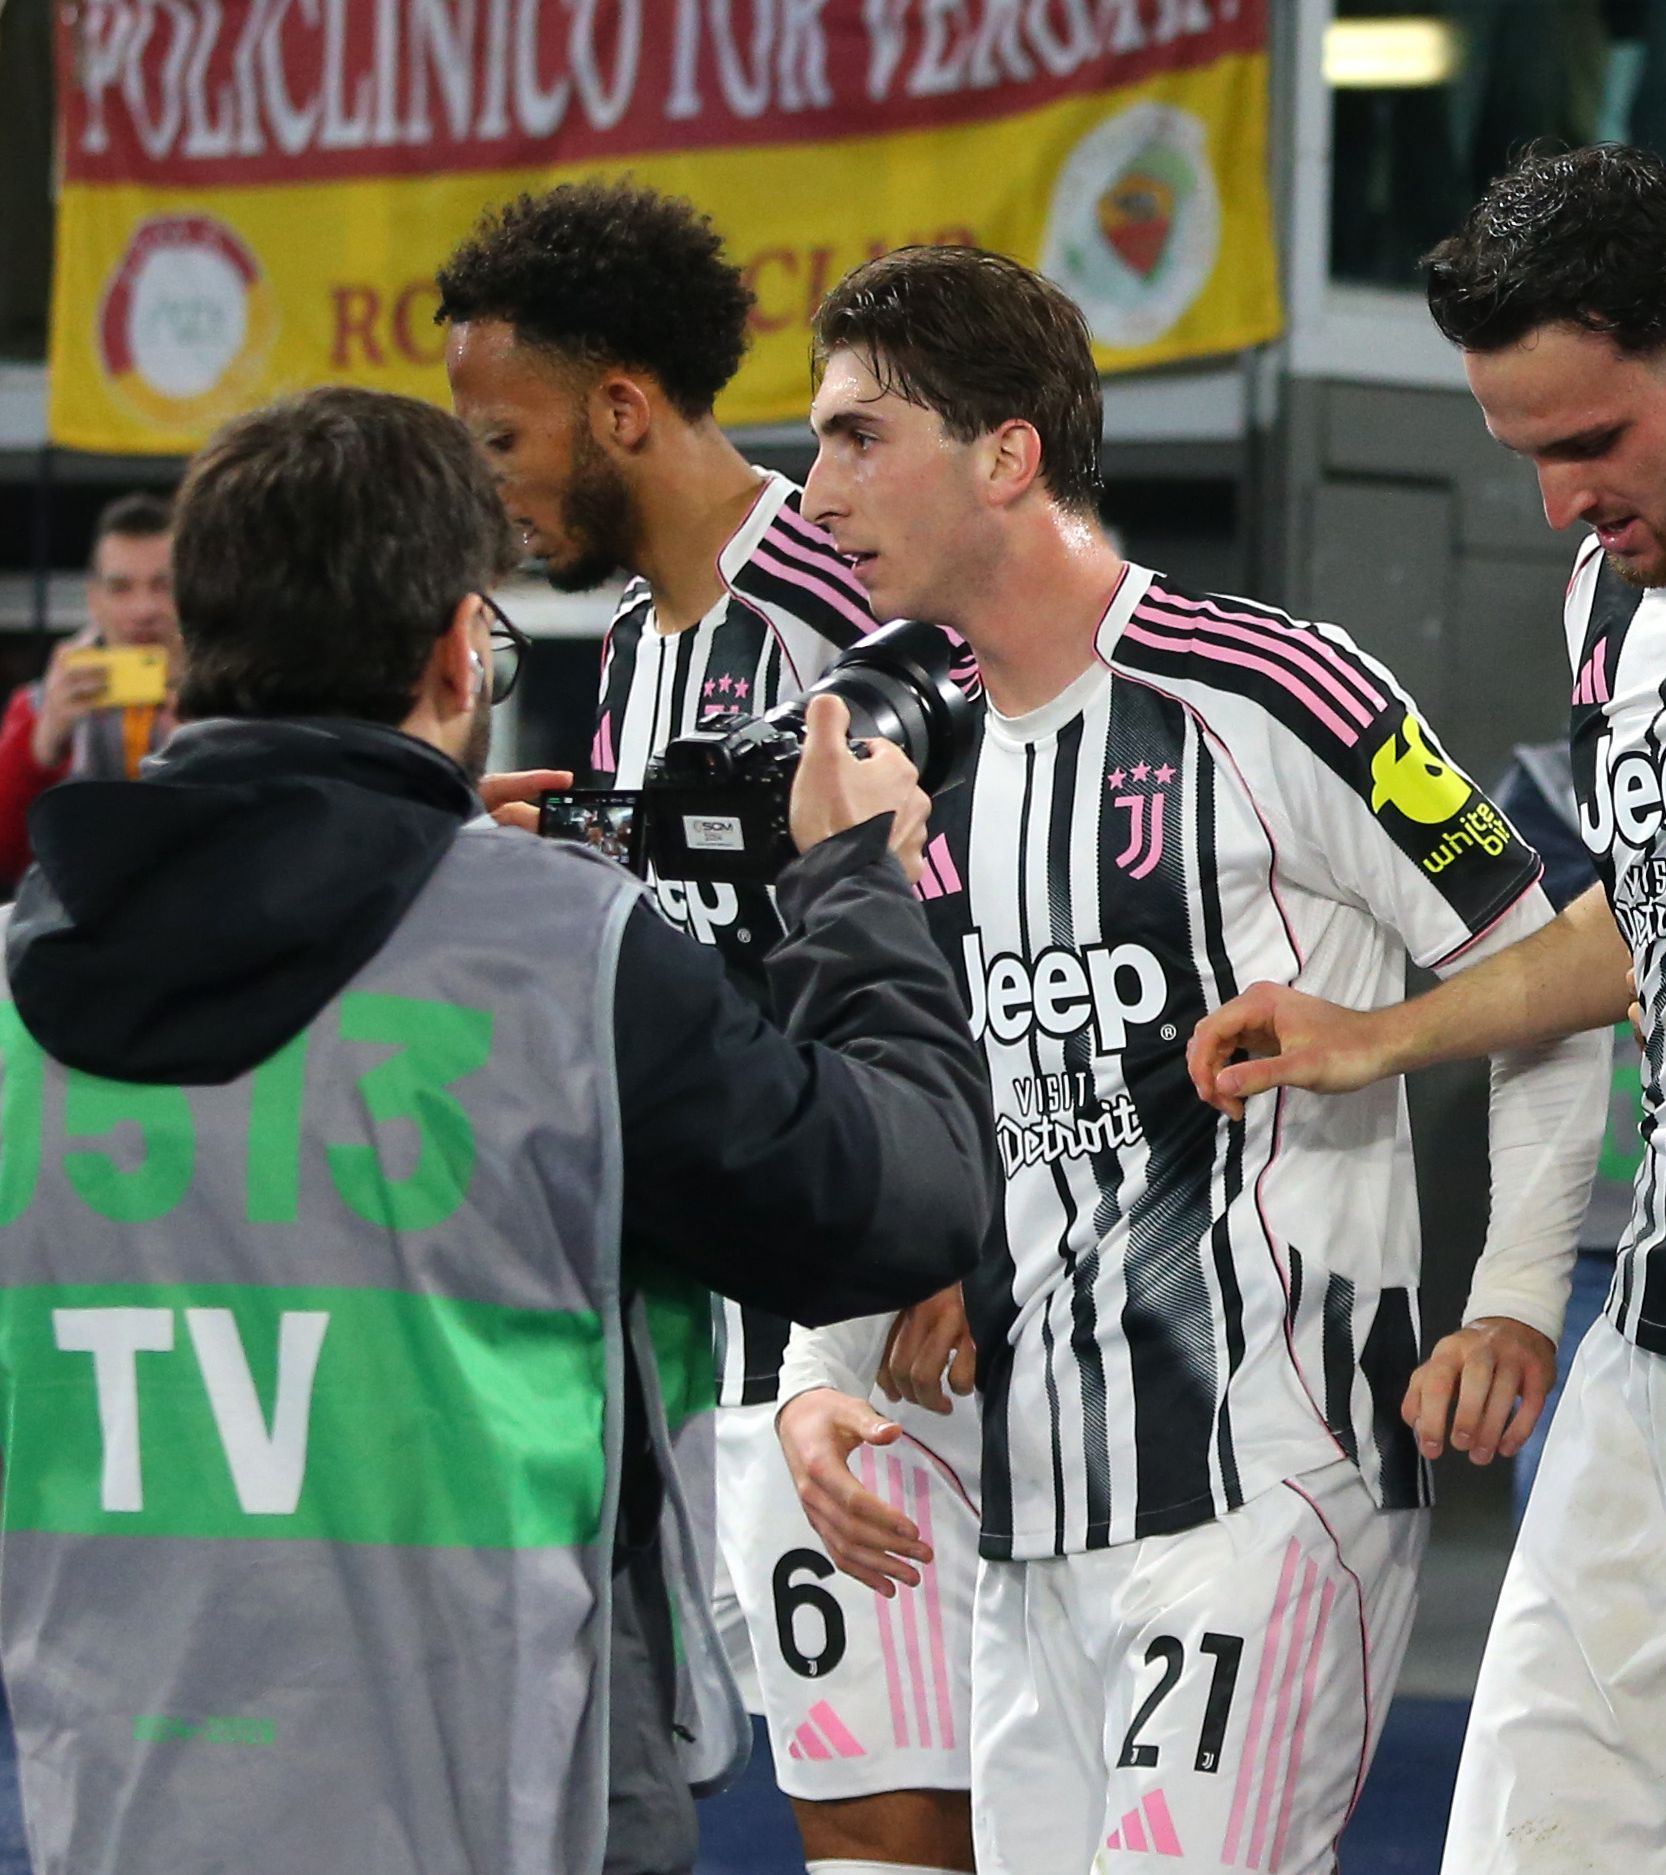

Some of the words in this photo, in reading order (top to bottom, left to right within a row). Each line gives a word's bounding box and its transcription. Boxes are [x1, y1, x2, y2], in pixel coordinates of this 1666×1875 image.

[82, 0, 642, 160] POLICLINICO
[664, 0, 834, 120] TOR
[1423, 803, 1495, 873] white
[962, 932, 1168, 1051] Jeep
[995, 1096, 1144, 1181] Detroit
[1012, 1071, 1087, 1117] VISIT
[52, 1306, 330, 1516] TV
[772, 1547, 847, 1680] 6
[1115, 1632, 1246, 1776] 21
